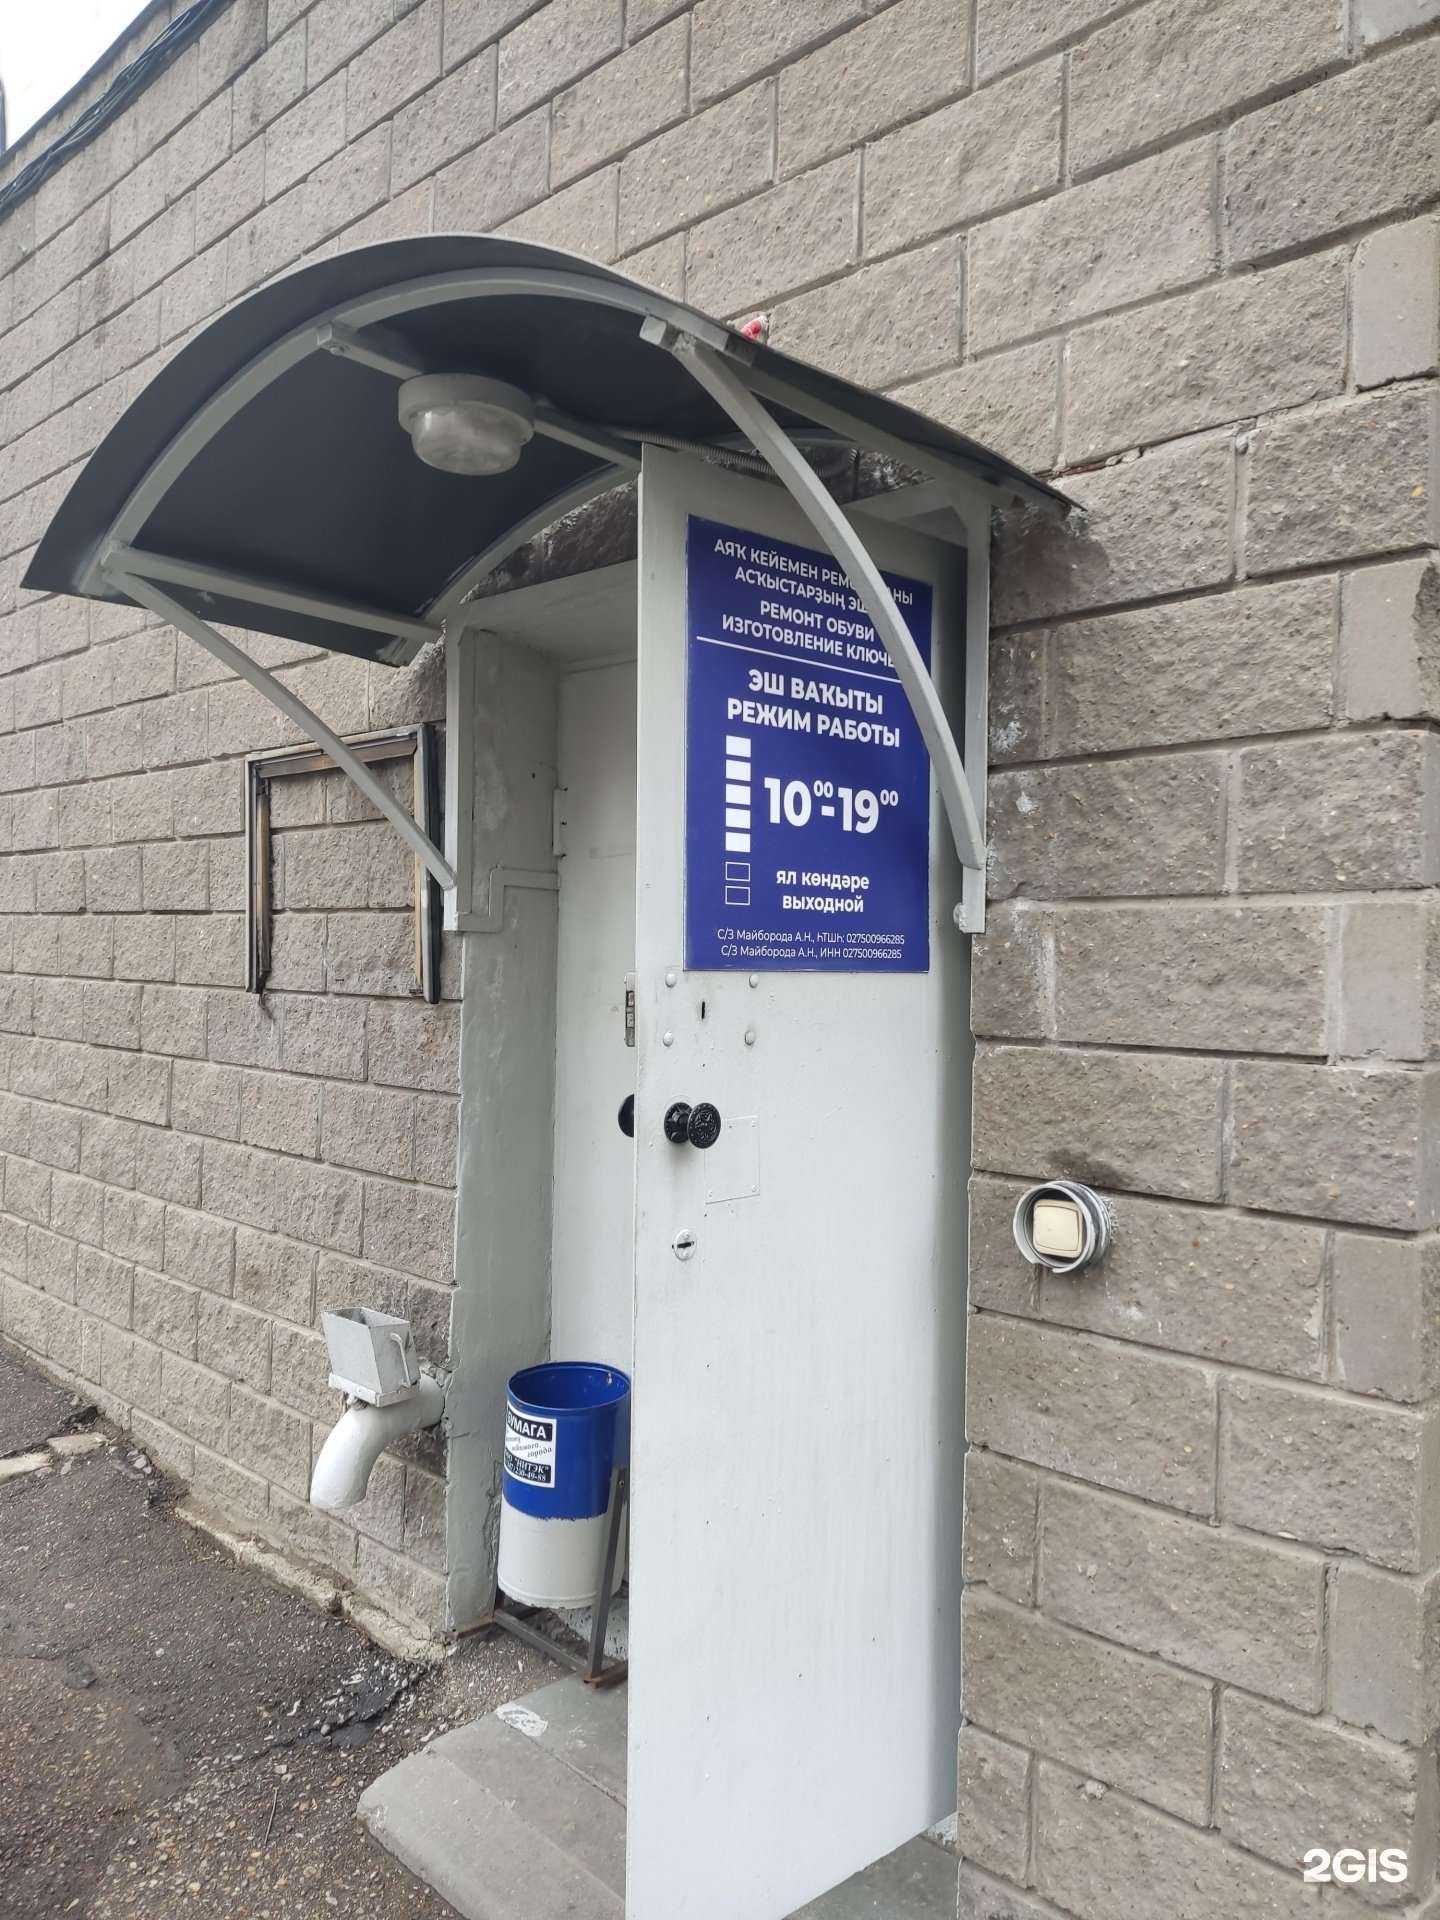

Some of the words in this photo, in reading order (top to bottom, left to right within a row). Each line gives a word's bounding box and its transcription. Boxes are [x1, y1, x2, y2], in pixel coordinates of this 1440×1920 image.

[714, 538, 747, 561] АЯҠ
[750, 548, 818, 580] КЕЙЕМЕН
[722, 614, 844, 657] ИЗГОТОВЛЕНИЕ
[760, 600, 824, 630] РЕМОНТ
[826, 616, 875, 643] ОБУВИ
[748, 668, 784, 697] ЭШ
[790, 677, 883, 715] ВАҠЫТЫ
[727, 697, 811, 733] РЕЖИМ
[816, 713, 900, 748] РАБОТЫ
[776, 870, 797, 885] ял
[782, 894, 864, 914] выходной
[736, 929, 793, 944] Майборода
[846, 933, 905, 945] 027500966285
[740, 945, 796, 959] Майборода
[820, 947, 841, 958] ИНН
[842, 947, 902, 959] 027500966285
